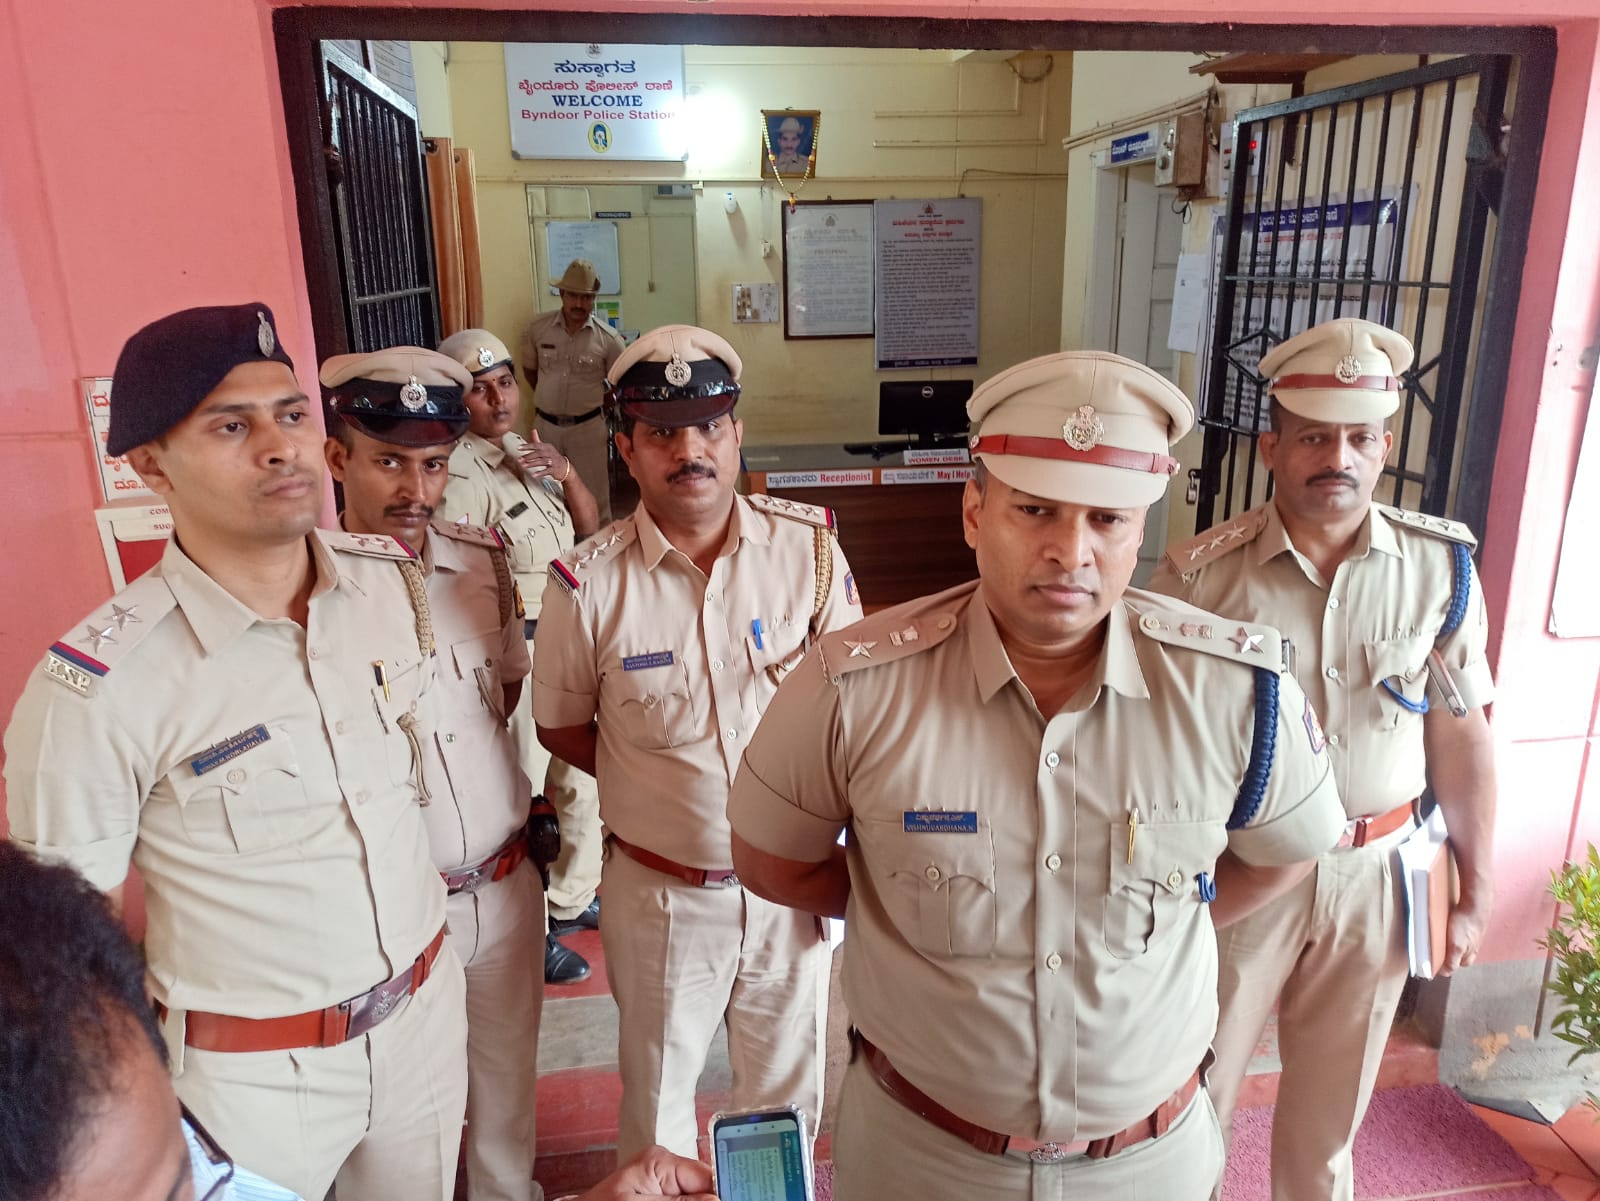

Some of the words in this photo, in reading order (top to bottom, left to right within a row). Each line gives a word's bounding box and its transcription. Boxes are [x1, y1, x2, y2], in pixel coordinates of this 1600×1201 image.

[554, 60, 637, 77] ಸುಸ್ವಾಗತ
[518, 79, 579, 96] ಬೈಂದೂರು
[551, 95, 643, 107] WELCOME
[521, 110, 579, 122] Byndoor
[584, 110, 625, 120] Police
[820, 472, 871, 484] Receptionist
[937, 471, 951, 480] May
[956, 470, 970, 480] Help
